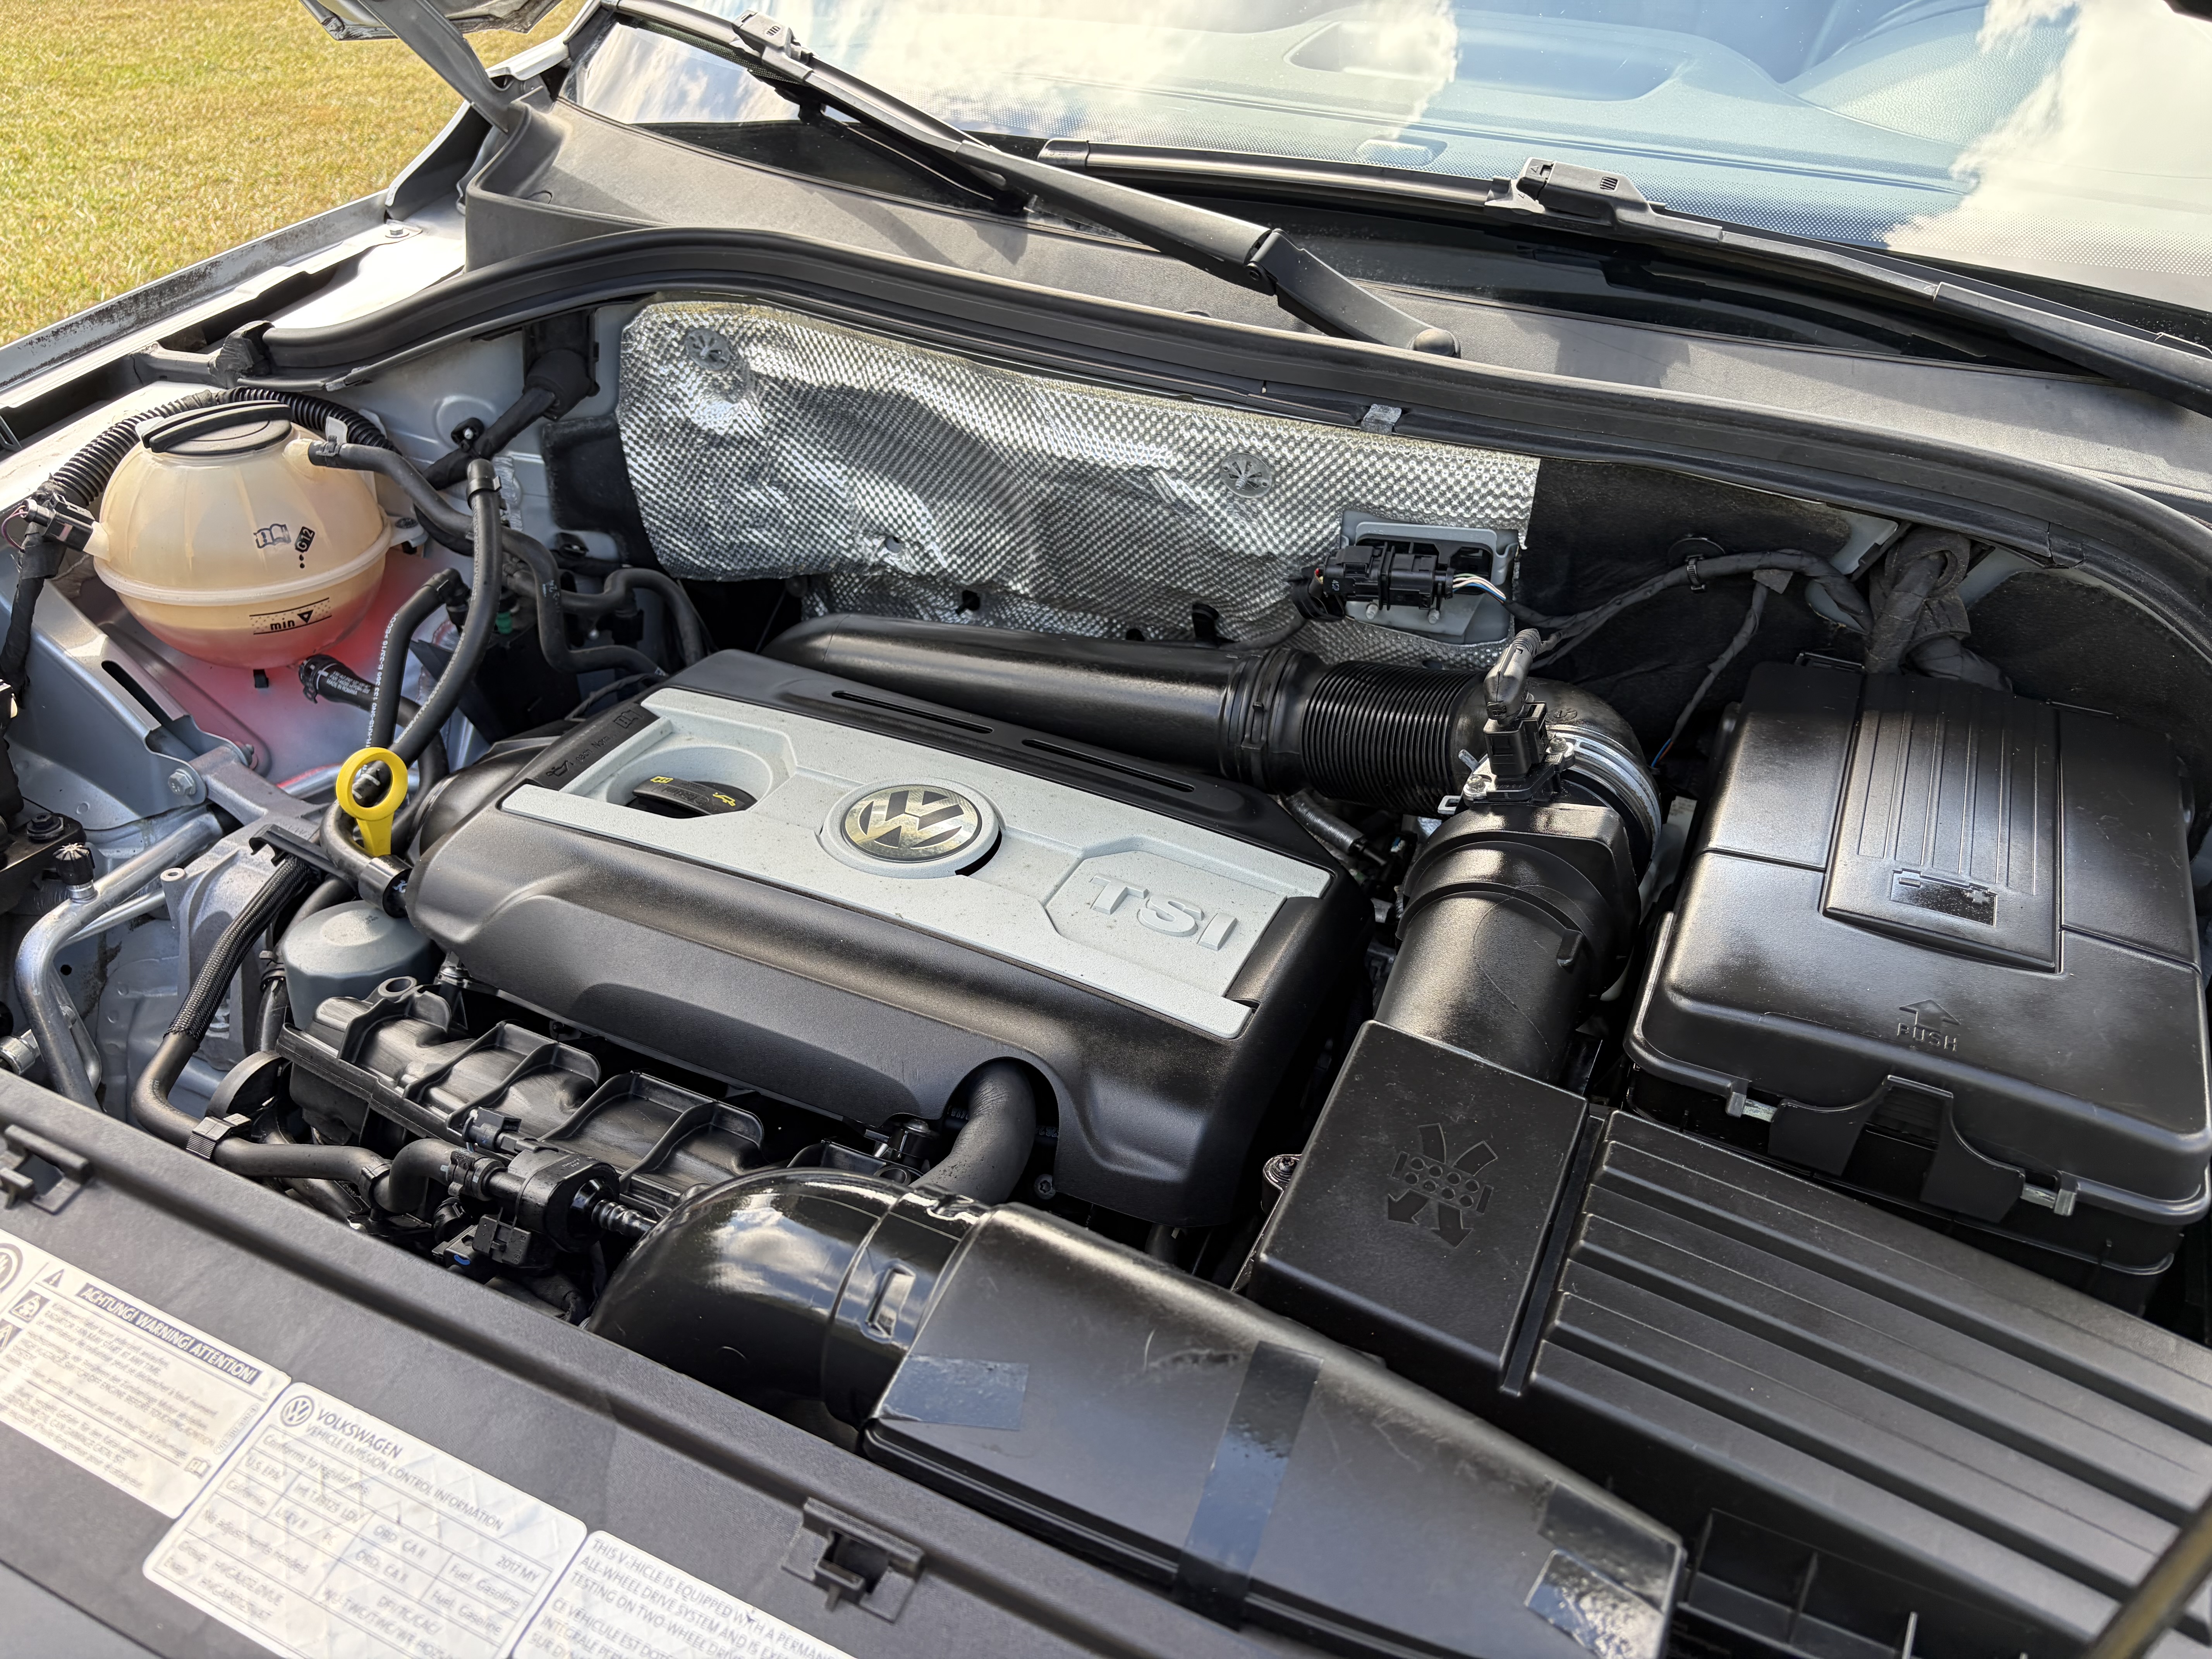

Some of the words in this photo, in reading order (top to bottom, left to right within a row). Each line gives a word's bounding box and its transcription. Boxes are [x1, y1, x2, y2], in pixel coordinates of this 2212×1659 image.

[270, 618, 295, 630] min
[1089, 873, 1238, 951] TSI
[1896, 1022, 1958, 1052] PUSH
[82, 1286, 139, 1322] ACHTUNG!
[134, 1312, 196, 1351] WARNING!
[189, 1340, 257, 1382] ATTENTION!
[260, 1433, 311, 1463] Conforms
[305, 1455, 321, 1468] to
[312, 1408, 405, 1460] VOLKSWAGEN
[302, 1423, 345, 1449] VEHICLE
[340, 1442, 392, 1472] EMISSION
[385, 1465, 438, 1496] CONTROL
[430, 1487, 508, 1531] INFORMATION
[242, 1455, 266, 1473] U.S.
[339, 1507, 364, 1525] LDV
[398, 1539, 421, 1556] CA
[472, 1578, 525, 1610] Gasoline
[494, 1554, 523, 1575] 2017
[517, 1566, 541, 1583] MY
[381, 1563, 404, 1580] CA
[454, 1602, 507, 1635] Gasoline
[550, 1596, 571, 1614] CE
[617, 1632, 644, 1652] EST
[566, 1570, 619, 1604] TESTING
[614, 1594, 639, 1613] ON
[632, 1604, 712, 1651] TWO-WHEEL
[577, 1554, 647, 1595] ALL-WHEEL
[639, 1585, 679, 1612] DRIVE
[673, 1602, 722, 1634] SYSTEM
[716, 1625, 750, 1649] AND
[744, 1639, 763, 1656] IS
[588, 1537, 620, 1560] THIS
[614, 1551, 666, 1583] VEHICLE
[660, 1574, 677, 1589] IS
[671, 1580, 736, 1620] EQUIPPED
[763, 1626, 779, 1642] A
[526, 1630, 557, 1652] SUR
